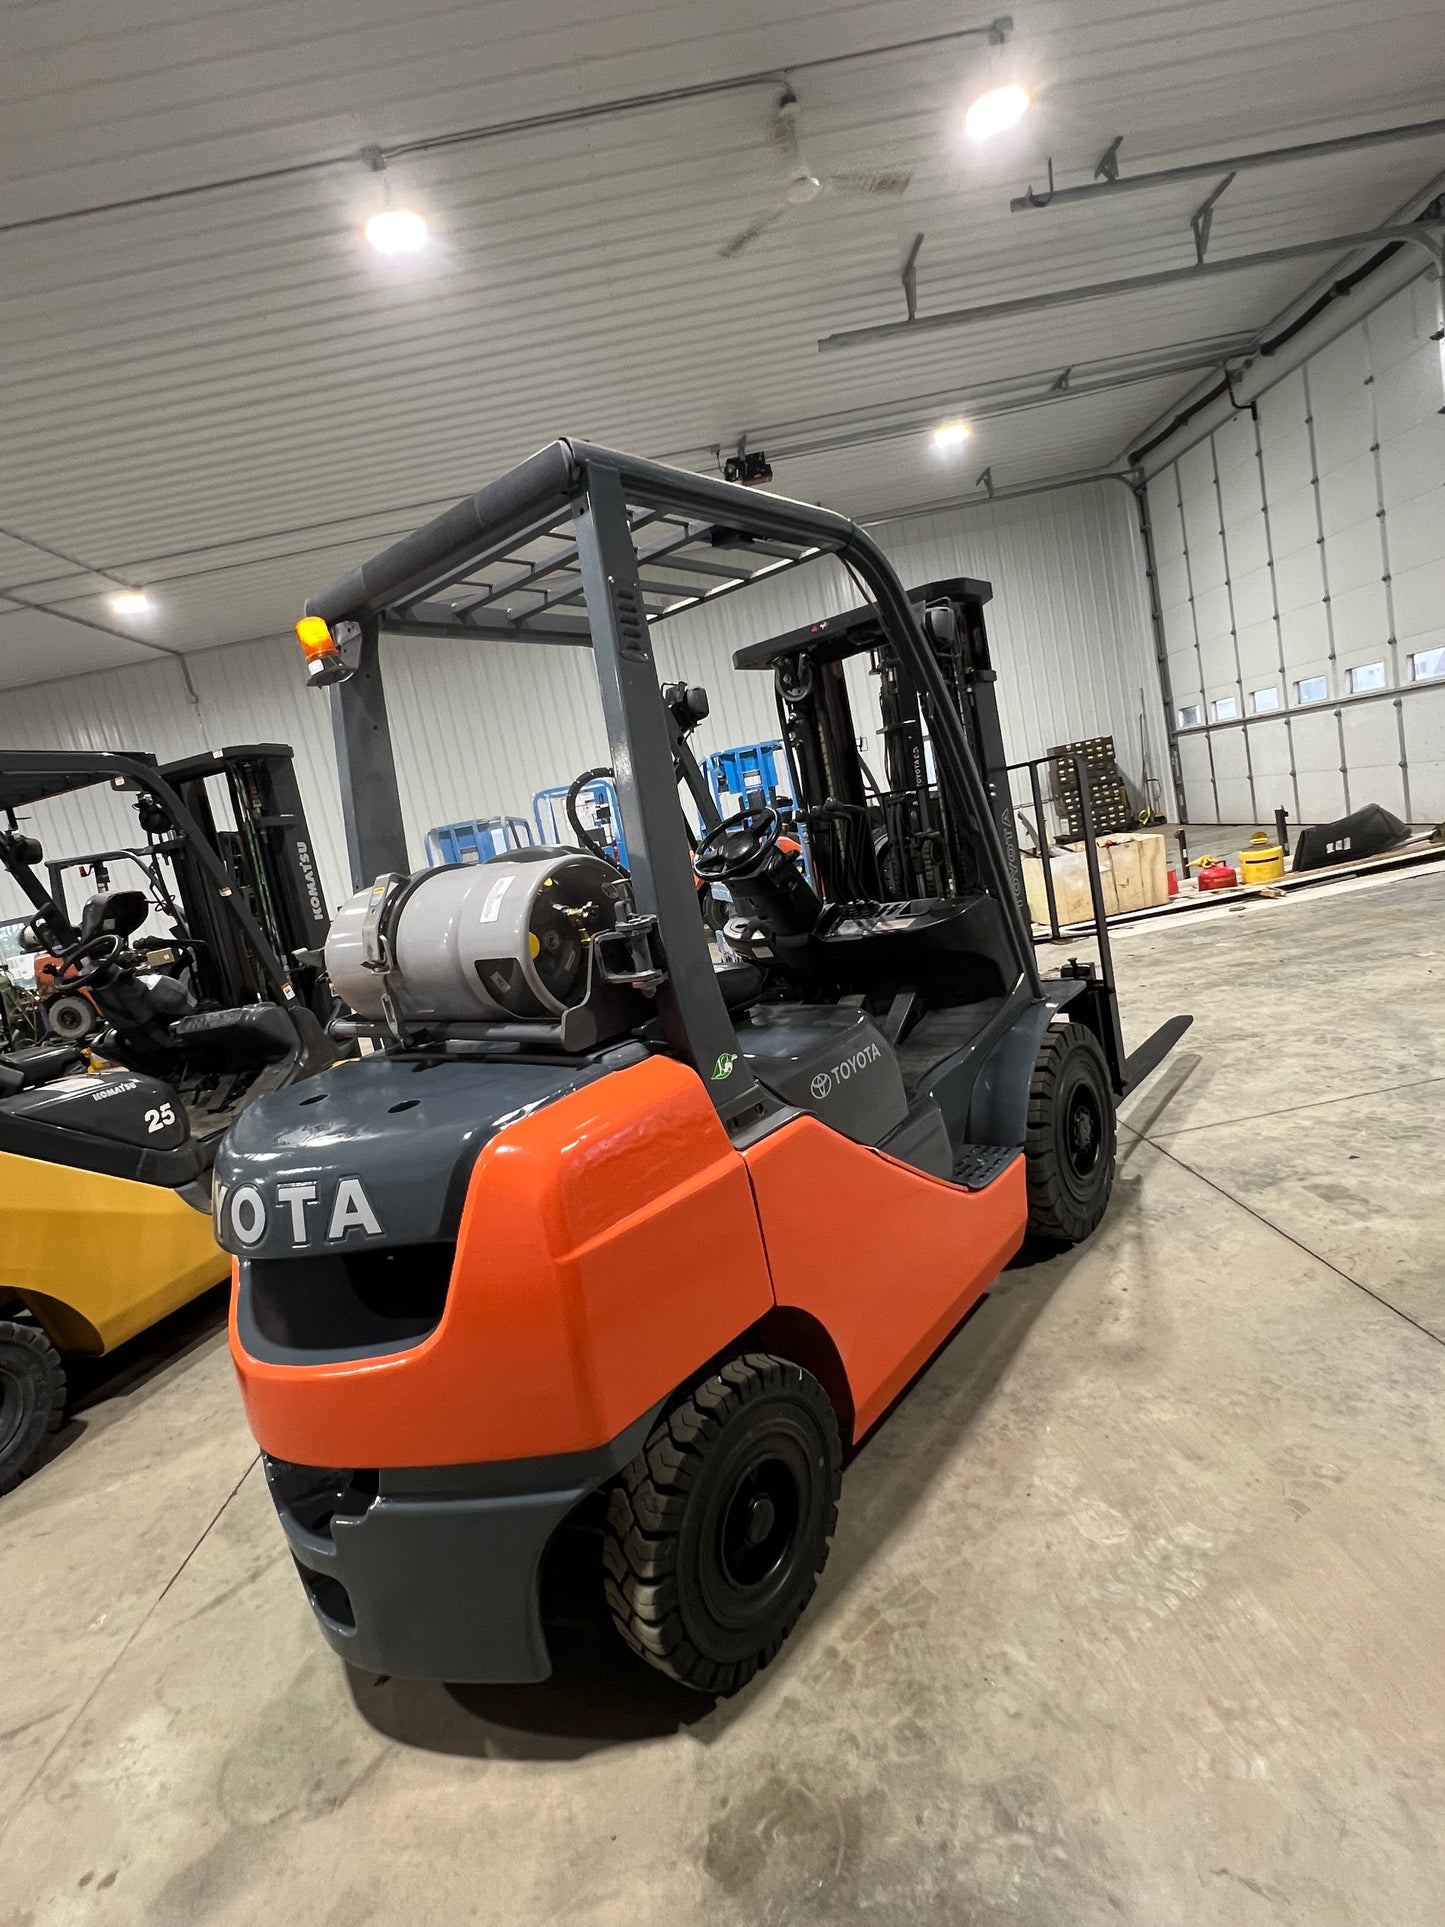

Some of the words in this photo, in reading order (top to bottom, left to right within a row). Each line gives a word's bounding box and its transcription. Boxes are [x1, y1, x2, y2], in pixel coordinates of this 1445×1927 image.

[914, 759, 922, 787] TOYOTA
[296, 841, 323, 920] KOMATSU
[831, 1043, 881, 1086] TOYOTA
[92, 1082, 137, 1101] KOMATSU
[144, 1102, 176, 1133] 25
[213, 1177, 383, 1244] YOTA
